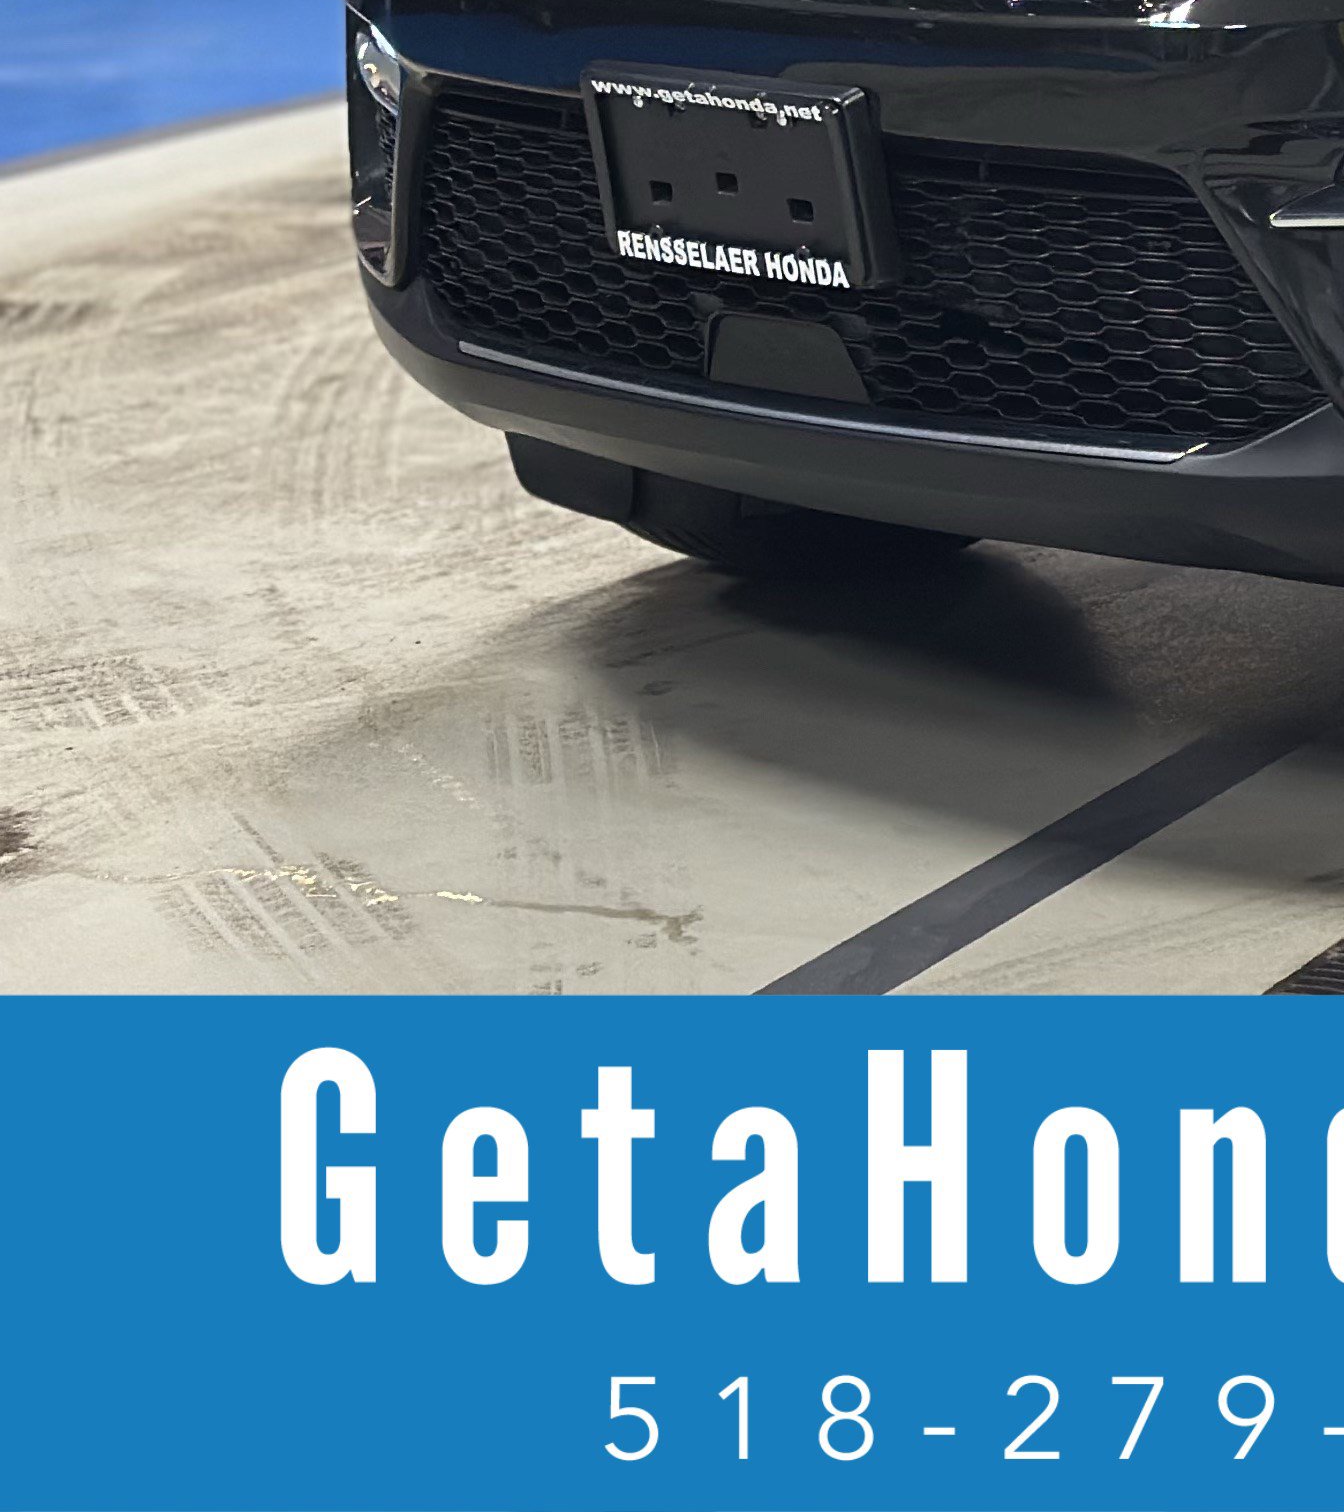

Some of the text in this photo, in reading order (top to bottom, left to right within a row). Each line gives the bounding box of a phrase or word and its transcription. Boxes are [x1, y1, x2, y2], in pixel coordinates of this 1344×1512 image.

[591, 79, 823, 122] www.getahonda.net
[617, 230, 850, 289] RENSSELAER HONDA
